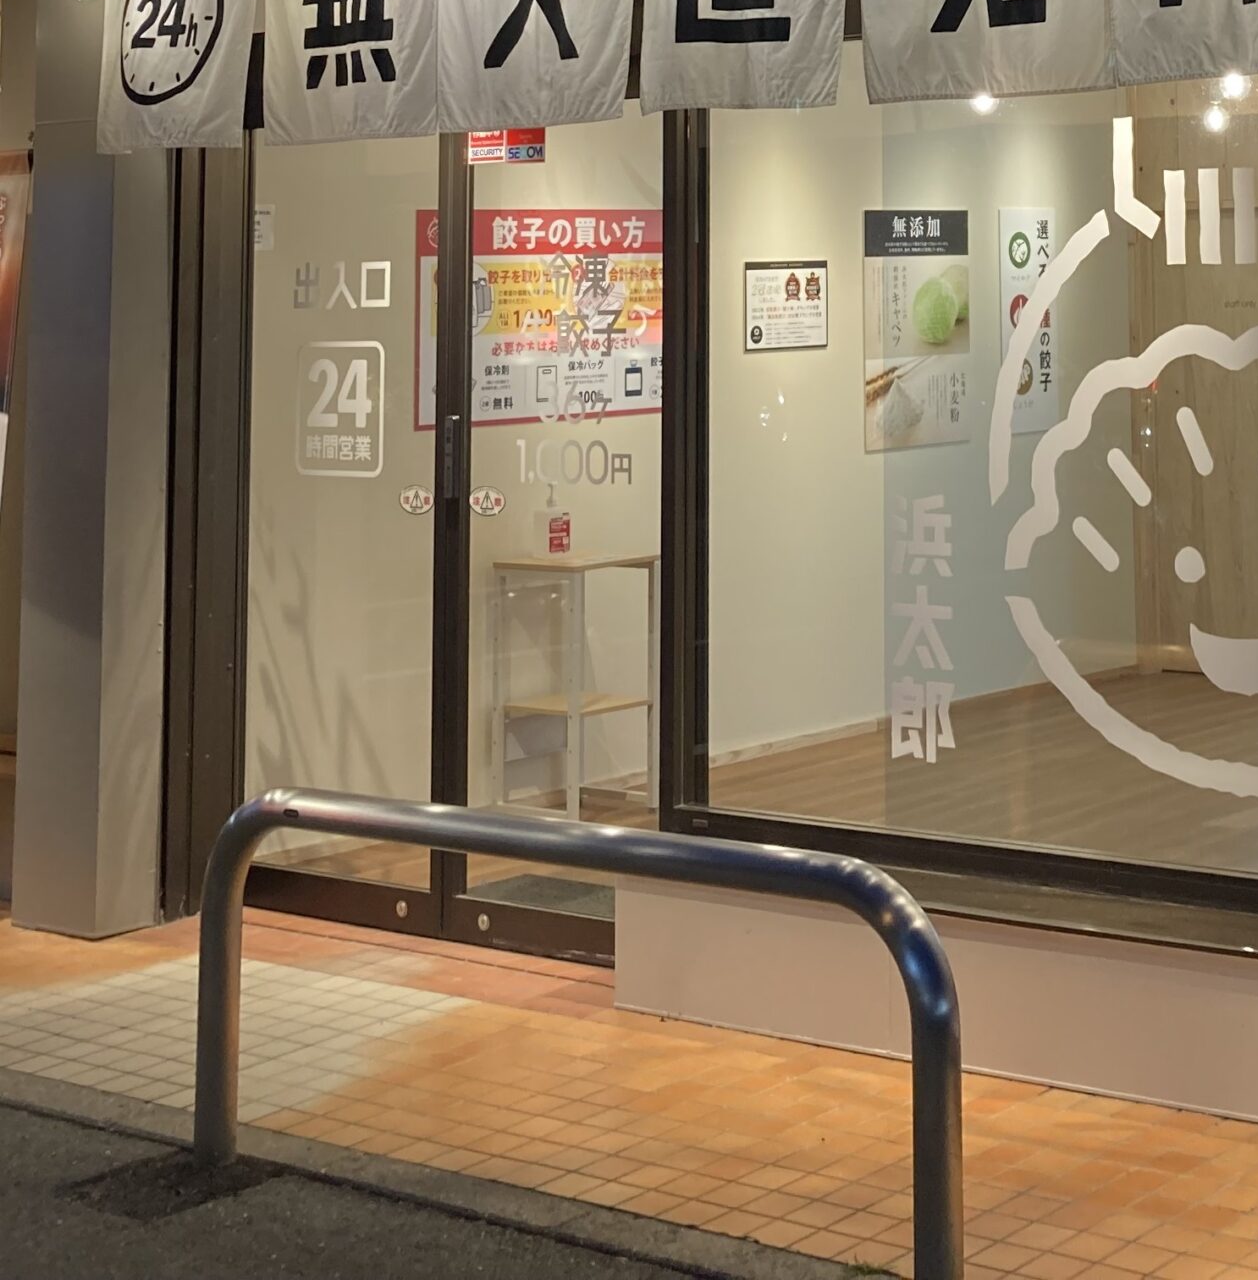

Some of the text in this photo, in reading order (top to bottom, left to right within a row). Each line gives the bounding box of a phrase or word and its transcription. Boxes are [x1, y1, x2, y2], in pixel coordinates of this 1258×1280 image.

[471, 148, 503, 157] SECURITY
[508, 146, 543, 160] SEOM
[491, 215, 647, 251] 餃子の買い方
[892, 215, 941, 238] 無添加
[293, 261, 392, 310] 出入口
[307, 358, 372, 428] 24
[305, 434, 372, 462] 時間営業
[516, 438, 632, 486] 1,000円
[890, 494, 956, 764] 浜太郎
